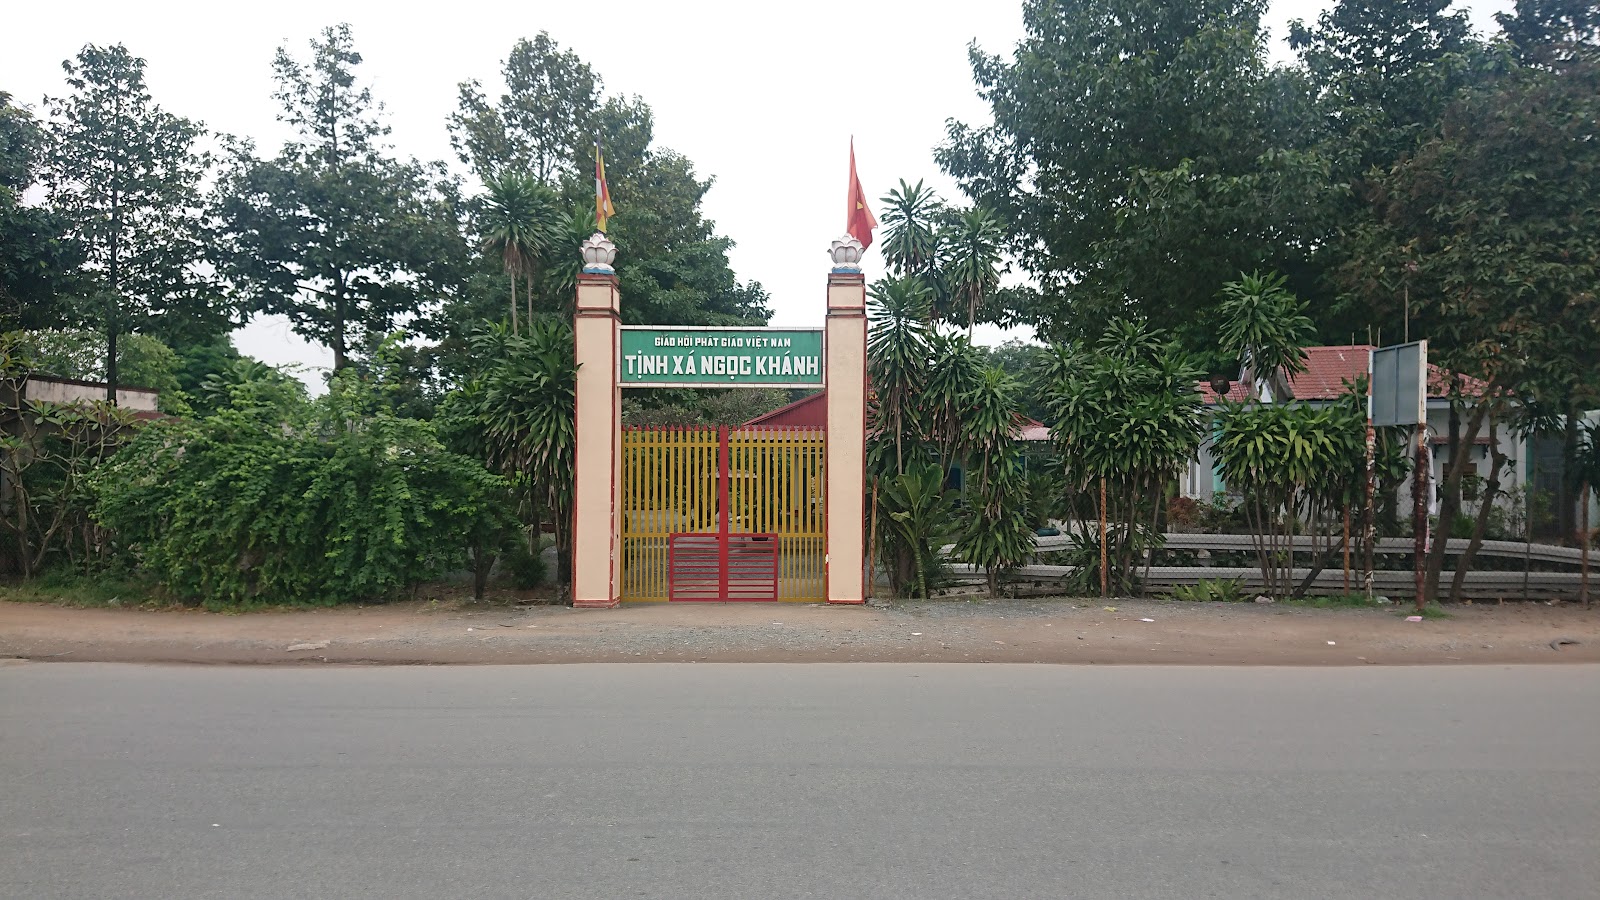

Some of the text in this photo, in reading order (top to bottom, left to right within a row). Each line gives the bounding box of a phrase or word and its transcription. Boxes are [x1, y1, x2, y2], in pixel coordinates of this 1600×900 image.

[654, 334, 676, 347] GIÁO
[677, 334, 693, 349] HỘI
[721, 334, 744, 348] GIÁO
[745, 334, 769, 350] VIỆT
[770, 337, 791, 348] NAM
[625, 350, 819, 380] TỊNH XÁ NGỌC KHÁNH
